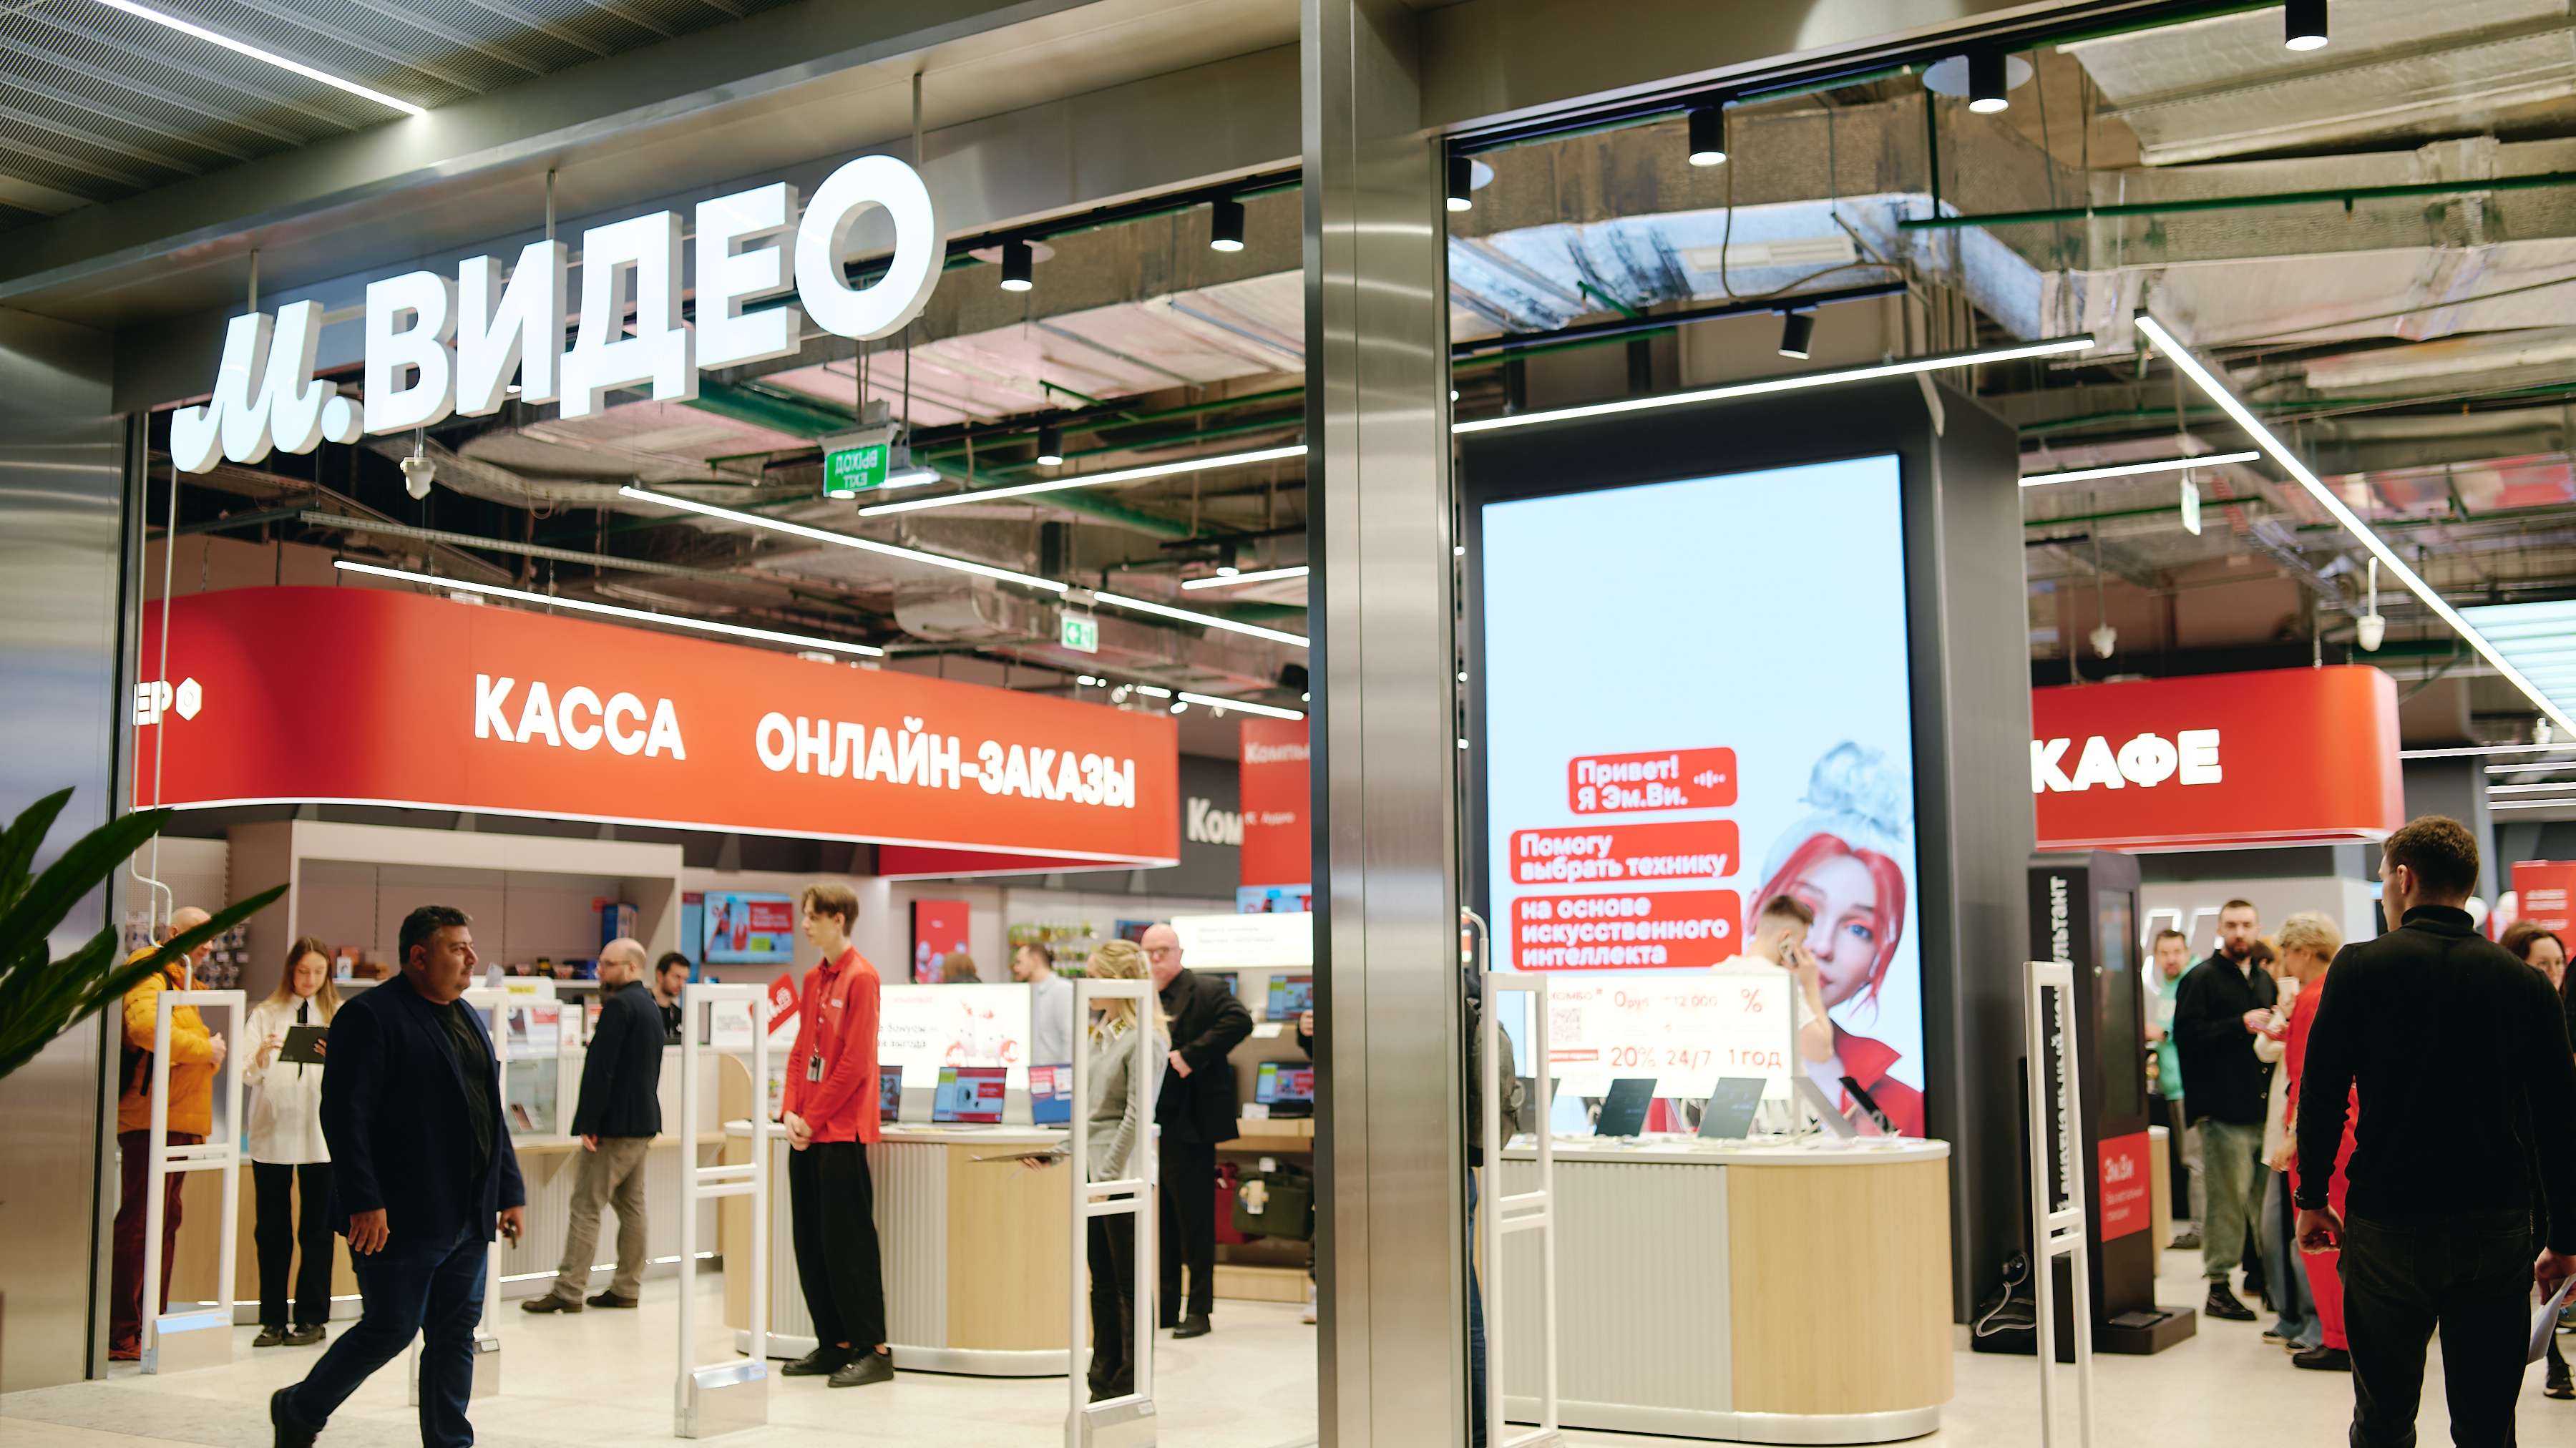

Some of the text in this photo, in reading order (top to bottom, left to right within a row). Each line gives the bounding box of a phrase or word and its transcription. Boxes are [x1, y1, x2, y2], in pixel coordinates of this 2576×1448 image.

[475, 673, 686, 760] КАССА
[755, 712, 1136, 809] ОНЛАЙН-ЗАКАЗЫ
[1577, 754, 1679, 788] Привет!
[2030, 728, 2223, 793] КАФЕ
[1578, 783, 1688, 811] Я Эм.Ви.
[1520, 833, 1613, 858] Помогу
[1520, 853, 1728, 883] выбрать технику
[1521, 896, 1652, 919] на основе
[1521, 919, 1729, 946] искусственного
[1522, 944, 1667, 967] интеллекта
[1741, 988, 1763, 1013] %
[1611, 1047, 1657, 1067] 20%
[1666, 1049, 1711, 1070] 24/7
